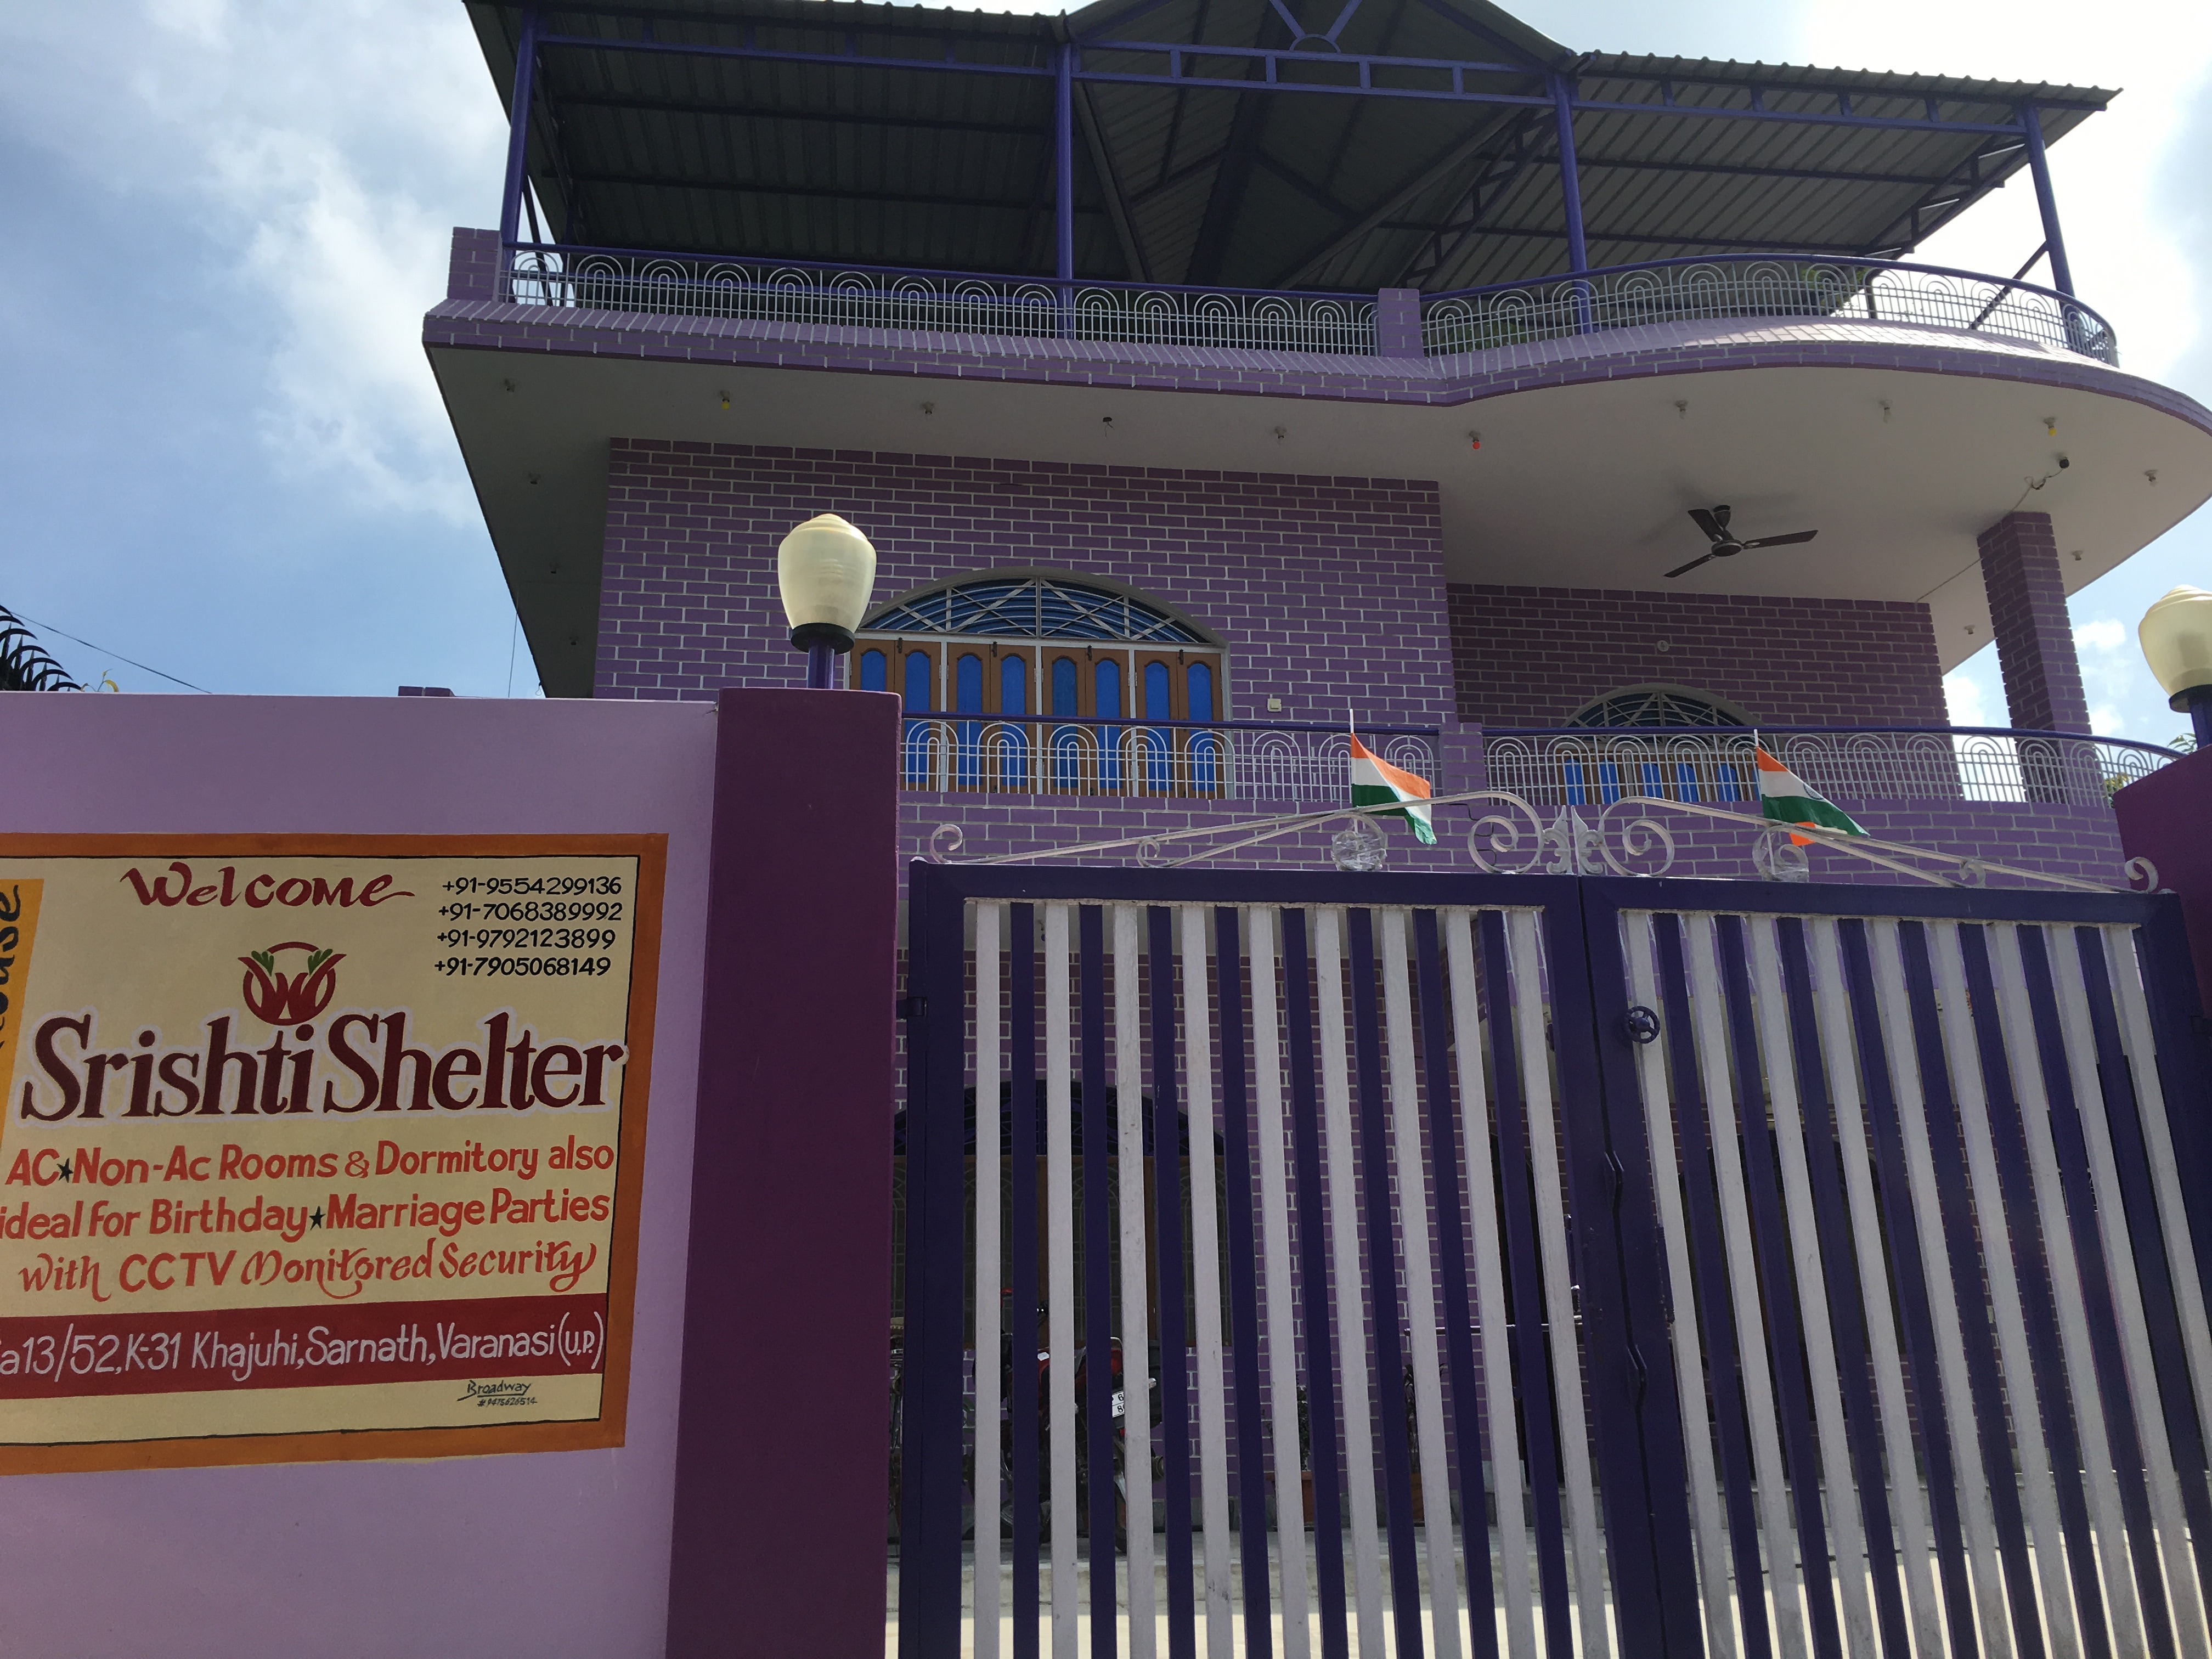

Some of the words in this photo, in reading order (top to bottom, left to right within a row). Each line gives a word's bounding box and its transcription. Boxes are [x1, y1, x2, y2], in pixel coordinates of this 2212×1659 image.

[120, 861, 415, 908] Welcome
[443, 877, 621, 895] +91-9554299136
[439, 902, 622, 921] +91-7068389992
[437, 928, 615, 950] +91-9792123899
[435, 957, 611, 976] +91-7905068149
[21, 1013, 315, 1121] Srishti
[324, 1012, 624, 1111] Shelter
[219, 1144, 338, 1180] Rooms
[345, 1151, 370, 1178] &
[376, 1140, 538, 1180] Dormitory
[548, 1135, 614, 1170] also
[0, 1200, 83, 1240] ideal
[88, 1200, 140, 1237] for
[149, 1195, 308, 1243] Birthday
[326, 1193, 485, 1237] Marriage
[490, 1187, 610, 1224] Parties
[18, 1253, 111, 1302] with
[119, 1250, 236, 1293] CCTV
[241, 1237, 436, 1299] Monitored
[439, 1240, 597, 1293] Security
[457, 1379, 531, 1401] Broadway
